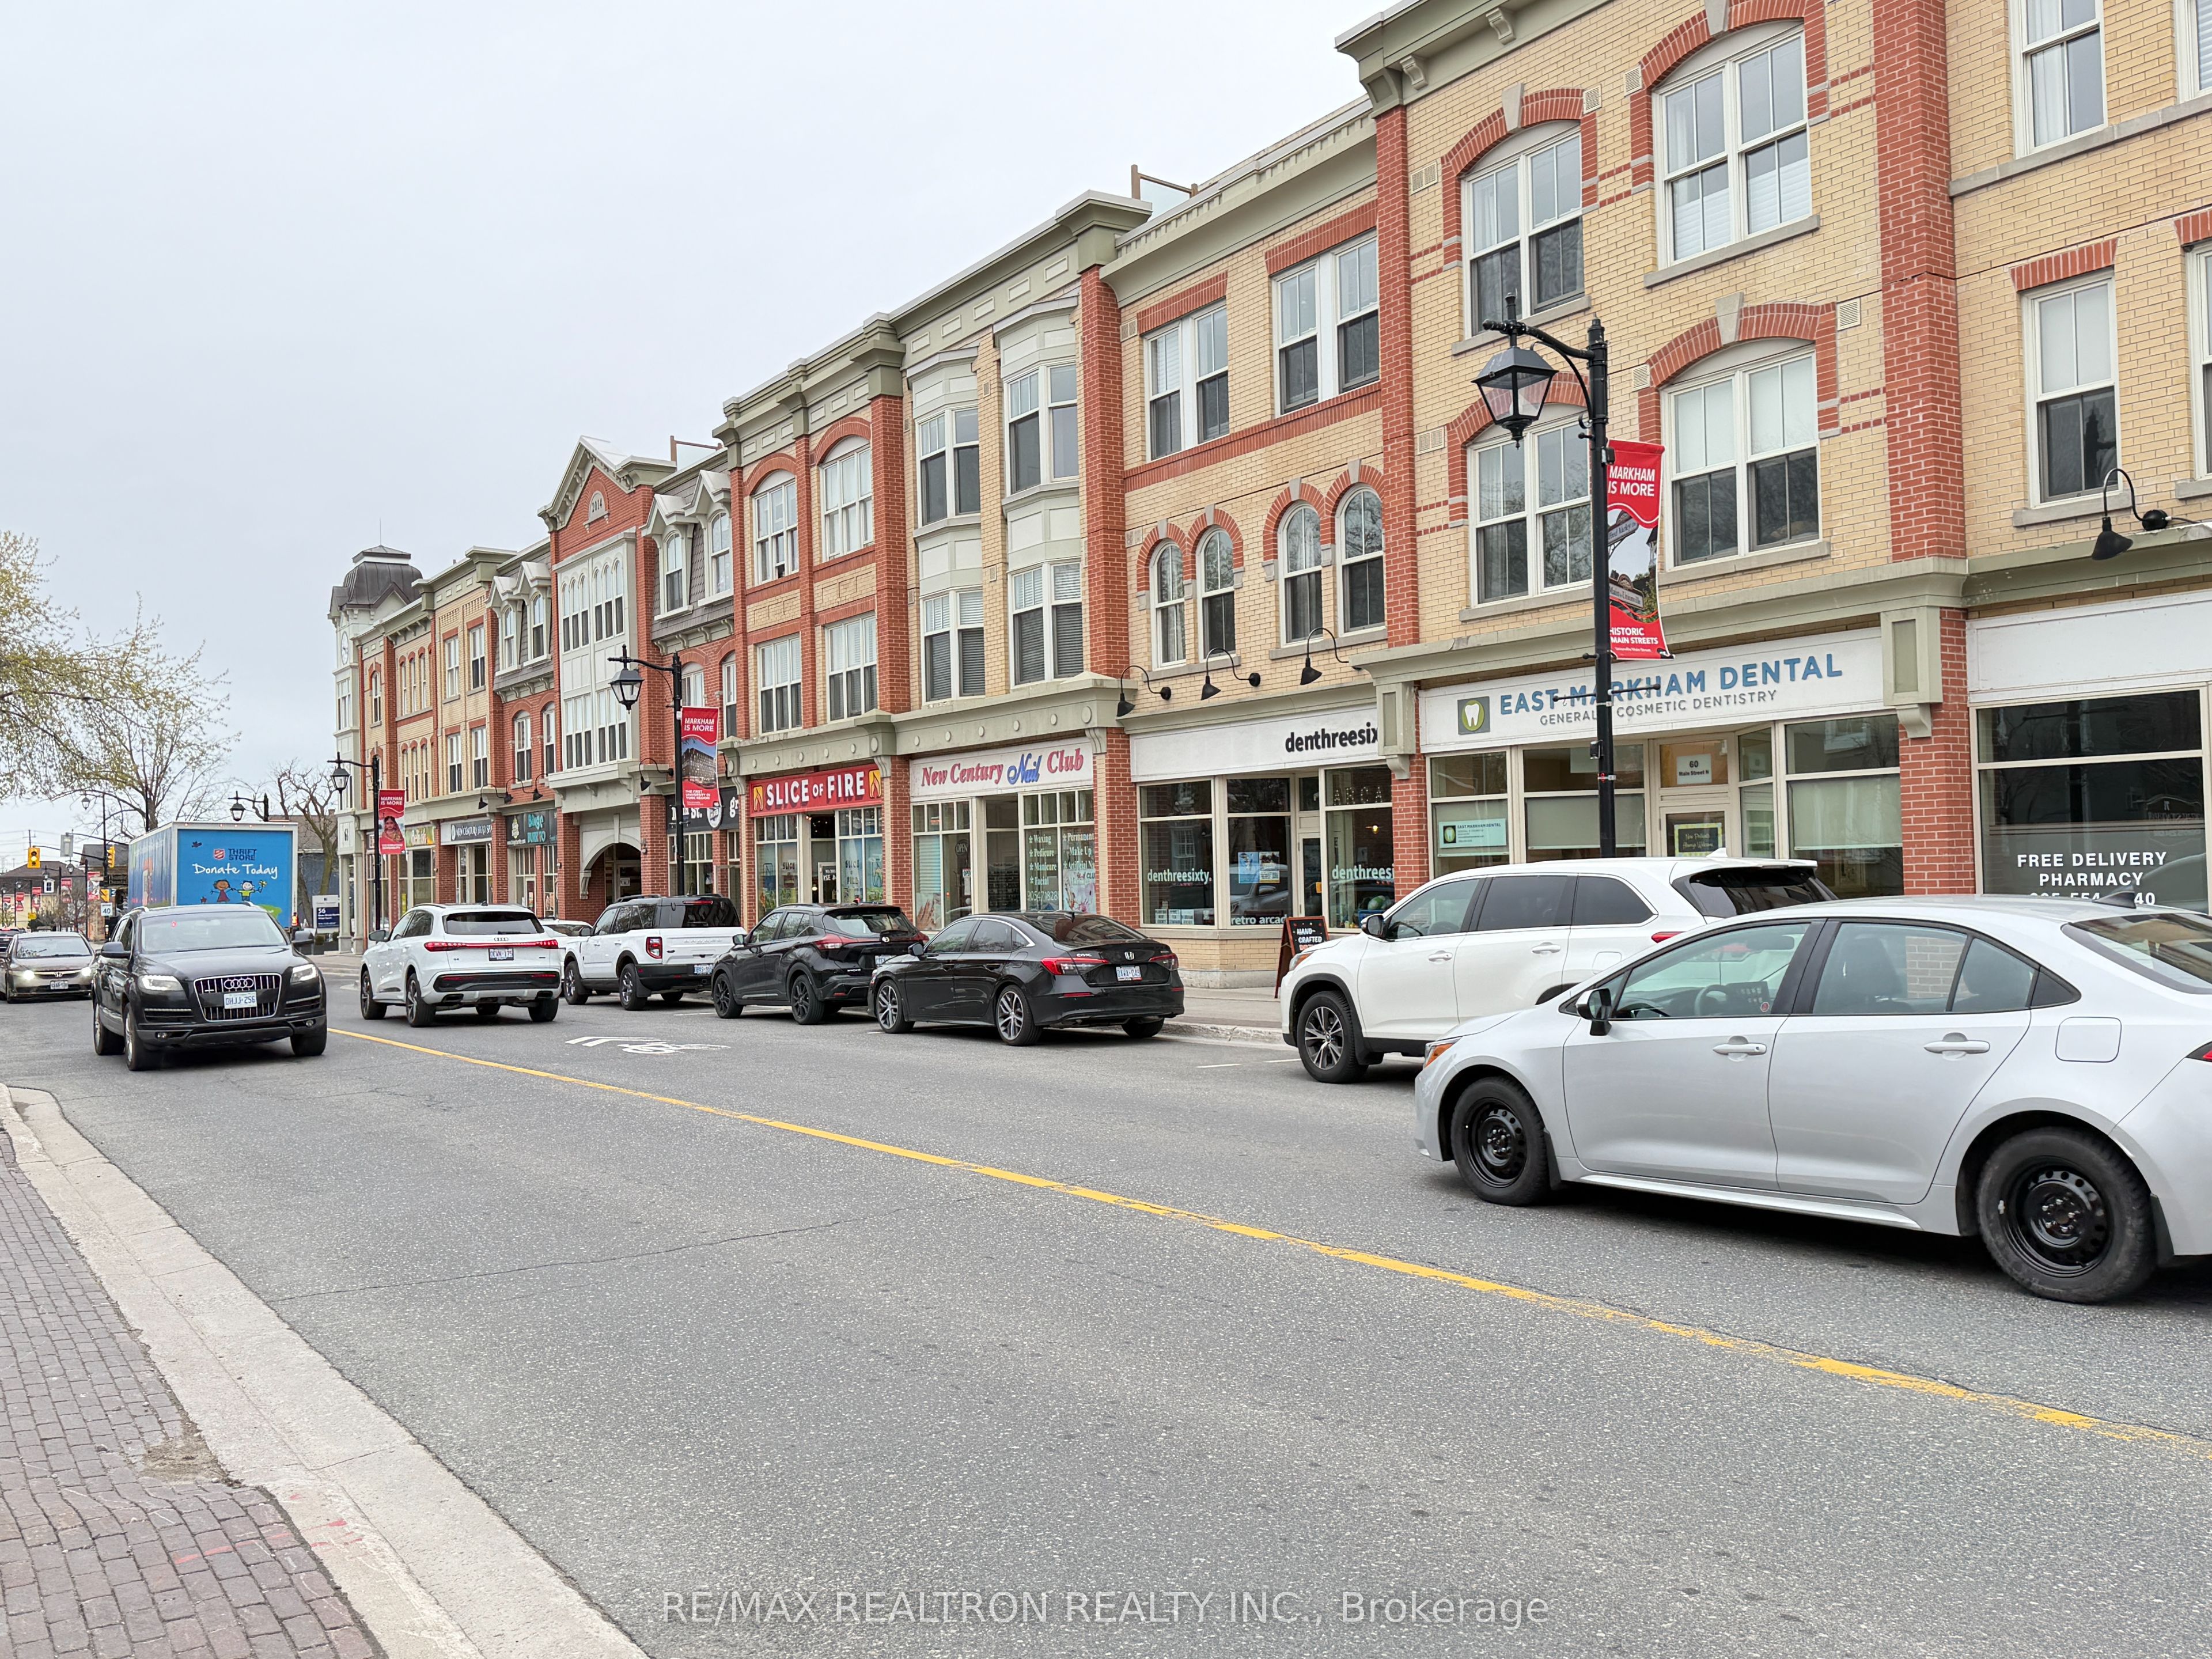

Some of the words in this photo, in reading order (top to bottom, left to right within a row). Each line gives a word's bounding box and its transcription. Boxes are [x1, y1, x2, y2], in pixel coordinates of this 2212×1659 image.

[1609, 465, 1656, 482] MARKHAM
[1608, 480, 1618, 494] IS
[1620, 482, 1655, 497] MORE
[1610, 627, 1645, 635] HISTORIC
[1501, 688, 1559, 715] EAST
[1570, 670, 1706, 707] MRKHAM
[1720, 653, 1843, 690] DENTAL
[1540, 710, 1597, 726] GENERAL
[1616, 700, 1687, 717] COSMETIC
[1693, 690, 1777, 709] DENTISTRY
[921, 766, 948, 786] New
[950, 763, 1003, 785] Century
[1007, 753, 1043, 785] Nail
[1047, 748, 1084, 774] Club
[1689, 760, 1699, 768] 60
[767, 779, 809, 806] SLICE
[812, 783, 824, 797] OF
[827, 771, 865, 799] FIRE
[1033, 834, 1052, 845] Waxing
[956, 843, 968, 853] OPEN
[1034, 848, 1055, 857] Pedicure
[1070, 846, 1083, 856] Make
[1084, 846, 1092, 858] Up
[1035, 862, 1057, 871] Manicure
[2017, 854, 2064, 868] FREE
[2073, 851, 2167, 867] DELIVERY
[192, 863, 240, 874] Donate
[242, 864, 278, 880] Today
[1147, 868, 1212, 885] denthreesixty.
[1035, 876, 1049, 885] Facial
[2039, 872, 2144, 887] PHARMACY
[1231, 916, 1256, 925] retro
